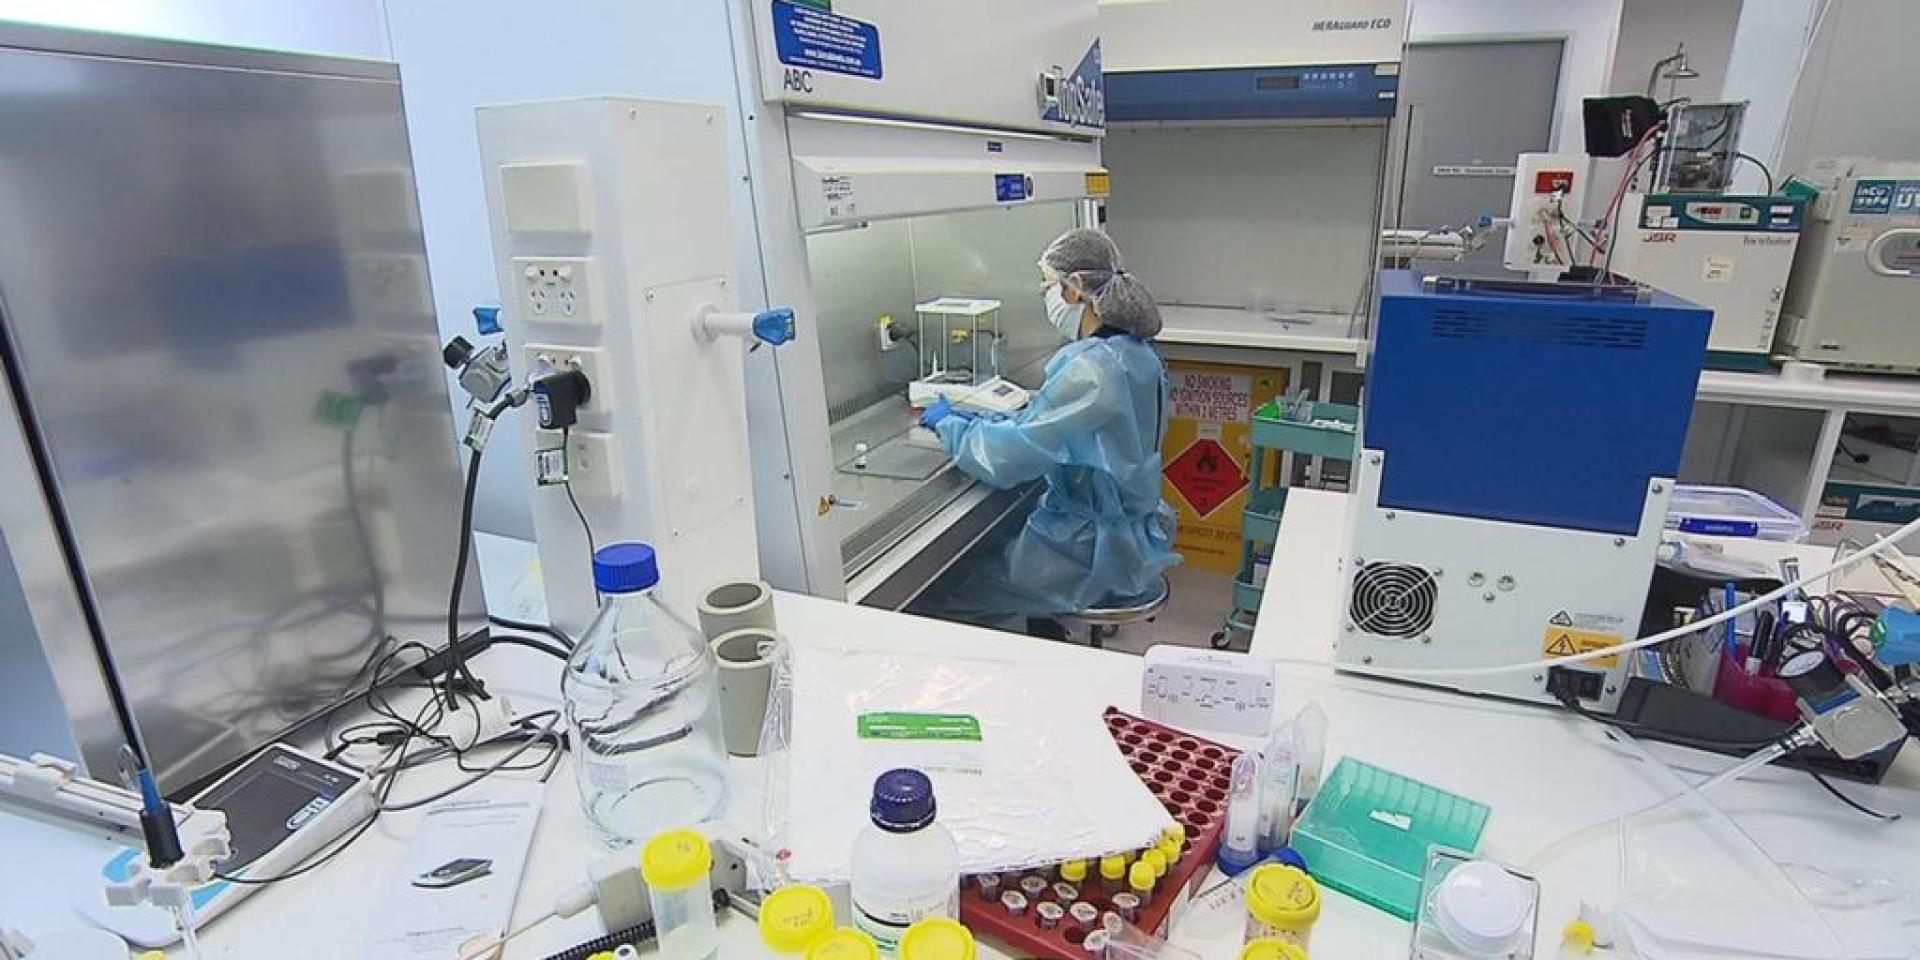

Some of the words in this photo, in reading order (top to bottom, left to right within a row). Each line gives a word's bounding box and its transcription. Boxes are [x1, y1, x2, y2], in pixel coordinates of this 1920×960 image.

[1370, 18, 1392, 29] ECO
[783, 68, 813, 93] ABC
[1643, 232, 1677, 243] JSR
[1200, 376, 1232, 391] SMOKING
